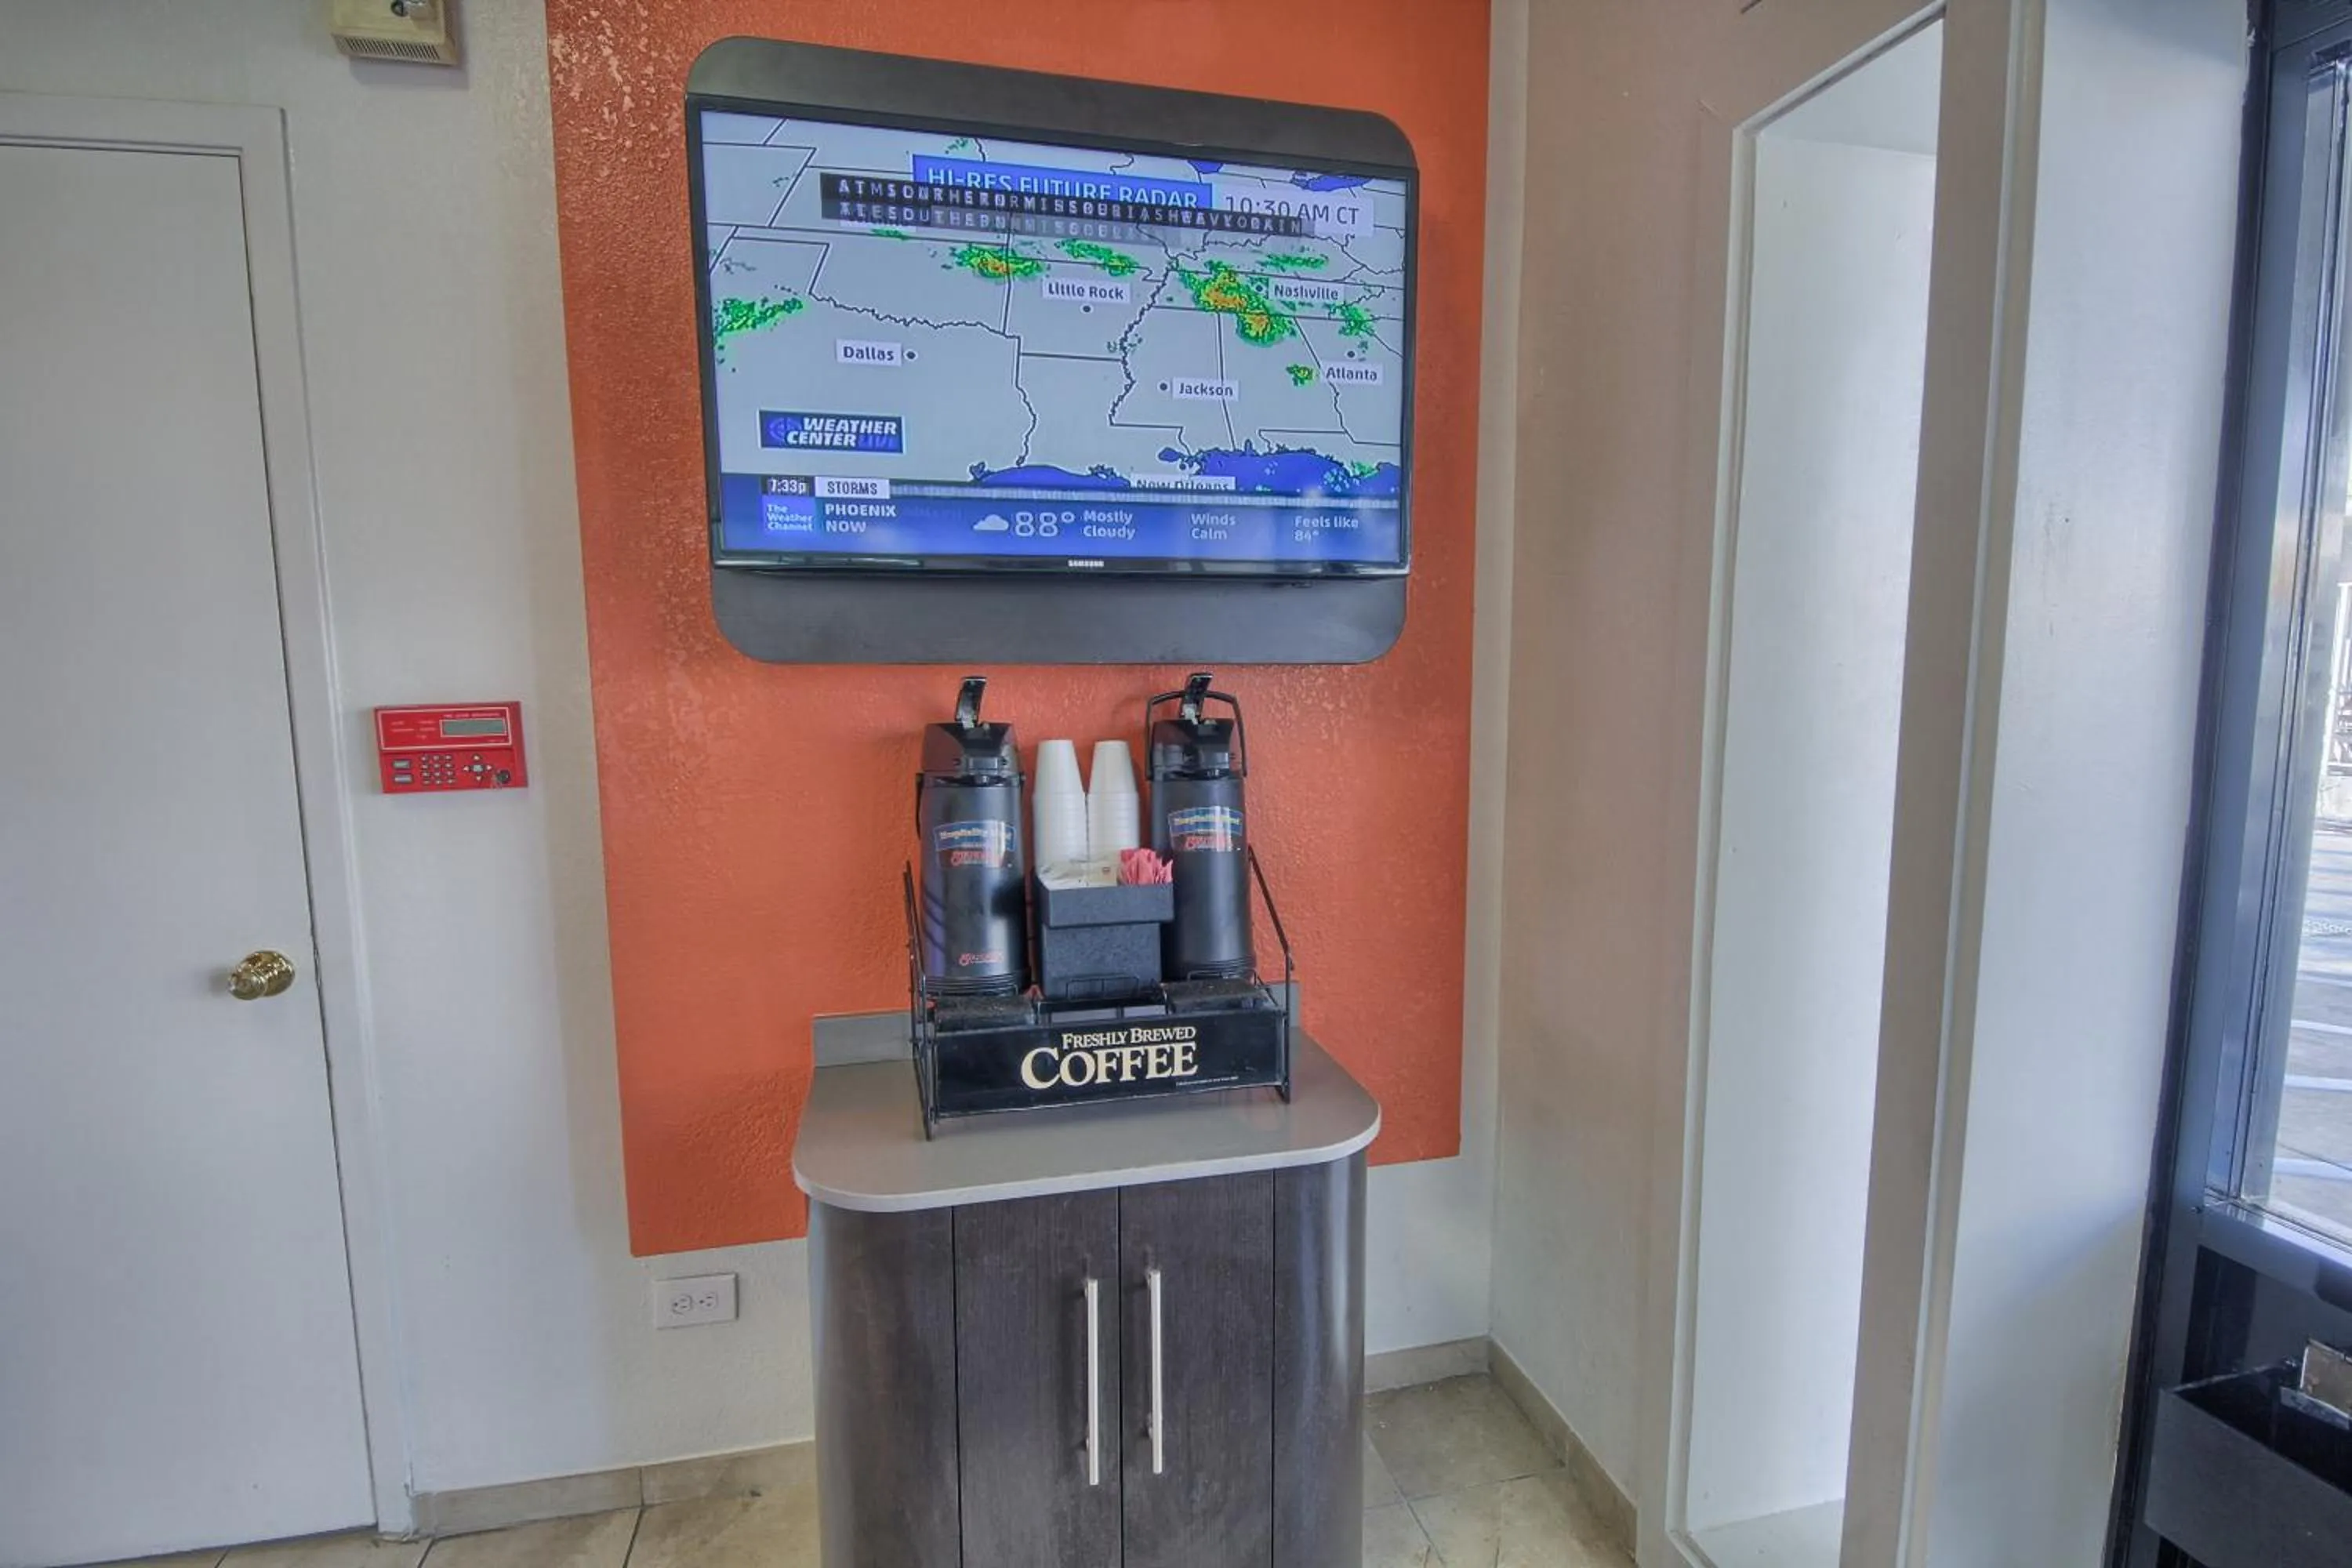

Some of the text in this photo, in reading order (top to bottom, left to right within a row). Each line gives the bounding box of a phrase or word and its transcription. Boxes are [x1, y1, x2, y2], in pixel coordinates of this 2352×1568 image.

[927, 168, 1011, 191] HI-RES
[1020, 176, 1112, 200] FUTURE
[1119, 186, 1198, 209] RADAR
[1225, 195, 1290, 217] 10:30
[1298, 203, 1330, 223] AM
[1337, 206, 1360, 225] CT
[1047, 284, 1124, 300] Little Rock
[1273, 285, 1340, 301] Nashville
[843, 346, 895, 361] Dallas
[1326, 366, 1378, 382] Atlanta
[1178, 383, 1234, 397] Jackson
[803, 416, 898, 435] WEATHER
[786, 430, 857, 448] CENTER
[827, 481, 878, 495] STORMS
[766, 503, 789, 513] The
[825, 503, 897, 517] PHOENIX
[766, 512, 814, 523] Weather
[1083, 510, 1134, 524] Mostly
[1190, 514, 1237, 527] Winds
[1294, 515, 1359, 529] Feels like
[766, 521, 814, 532] Channel
[825, 521, 867, 533] NOW
[1083, 525, 1136, 540] Cloudy
[1190, 528, 1228, 540] Calm
[1067, 559, 1105, 568] SAMSUNG
[1062, 1025, 1196, 1050] FRESHLY BREWED
[1021, 1041, 1199, 1090] COFFEE
